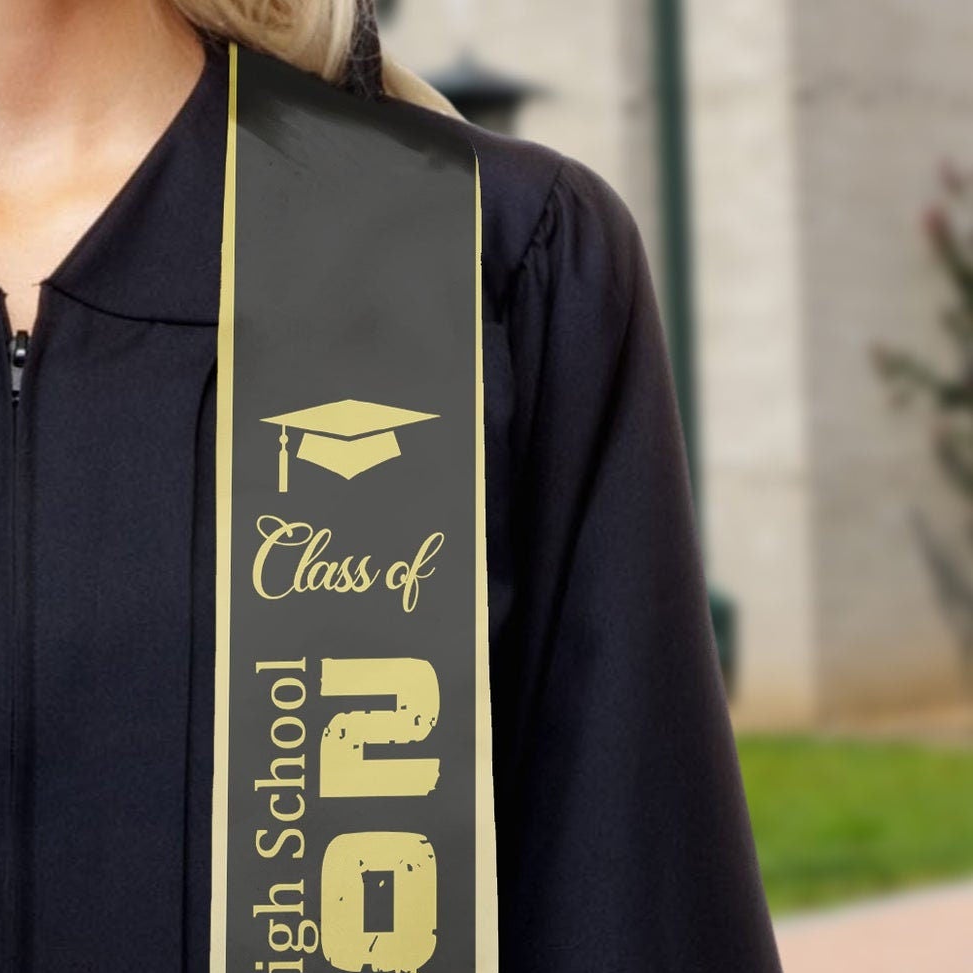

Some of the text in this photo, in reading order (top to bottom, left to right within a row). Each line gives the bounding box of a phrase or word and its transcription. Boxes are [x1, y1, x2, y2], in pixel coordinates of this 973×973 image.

[251, 514, 445, 614] Class of
[253, 656, 308, 859] School
